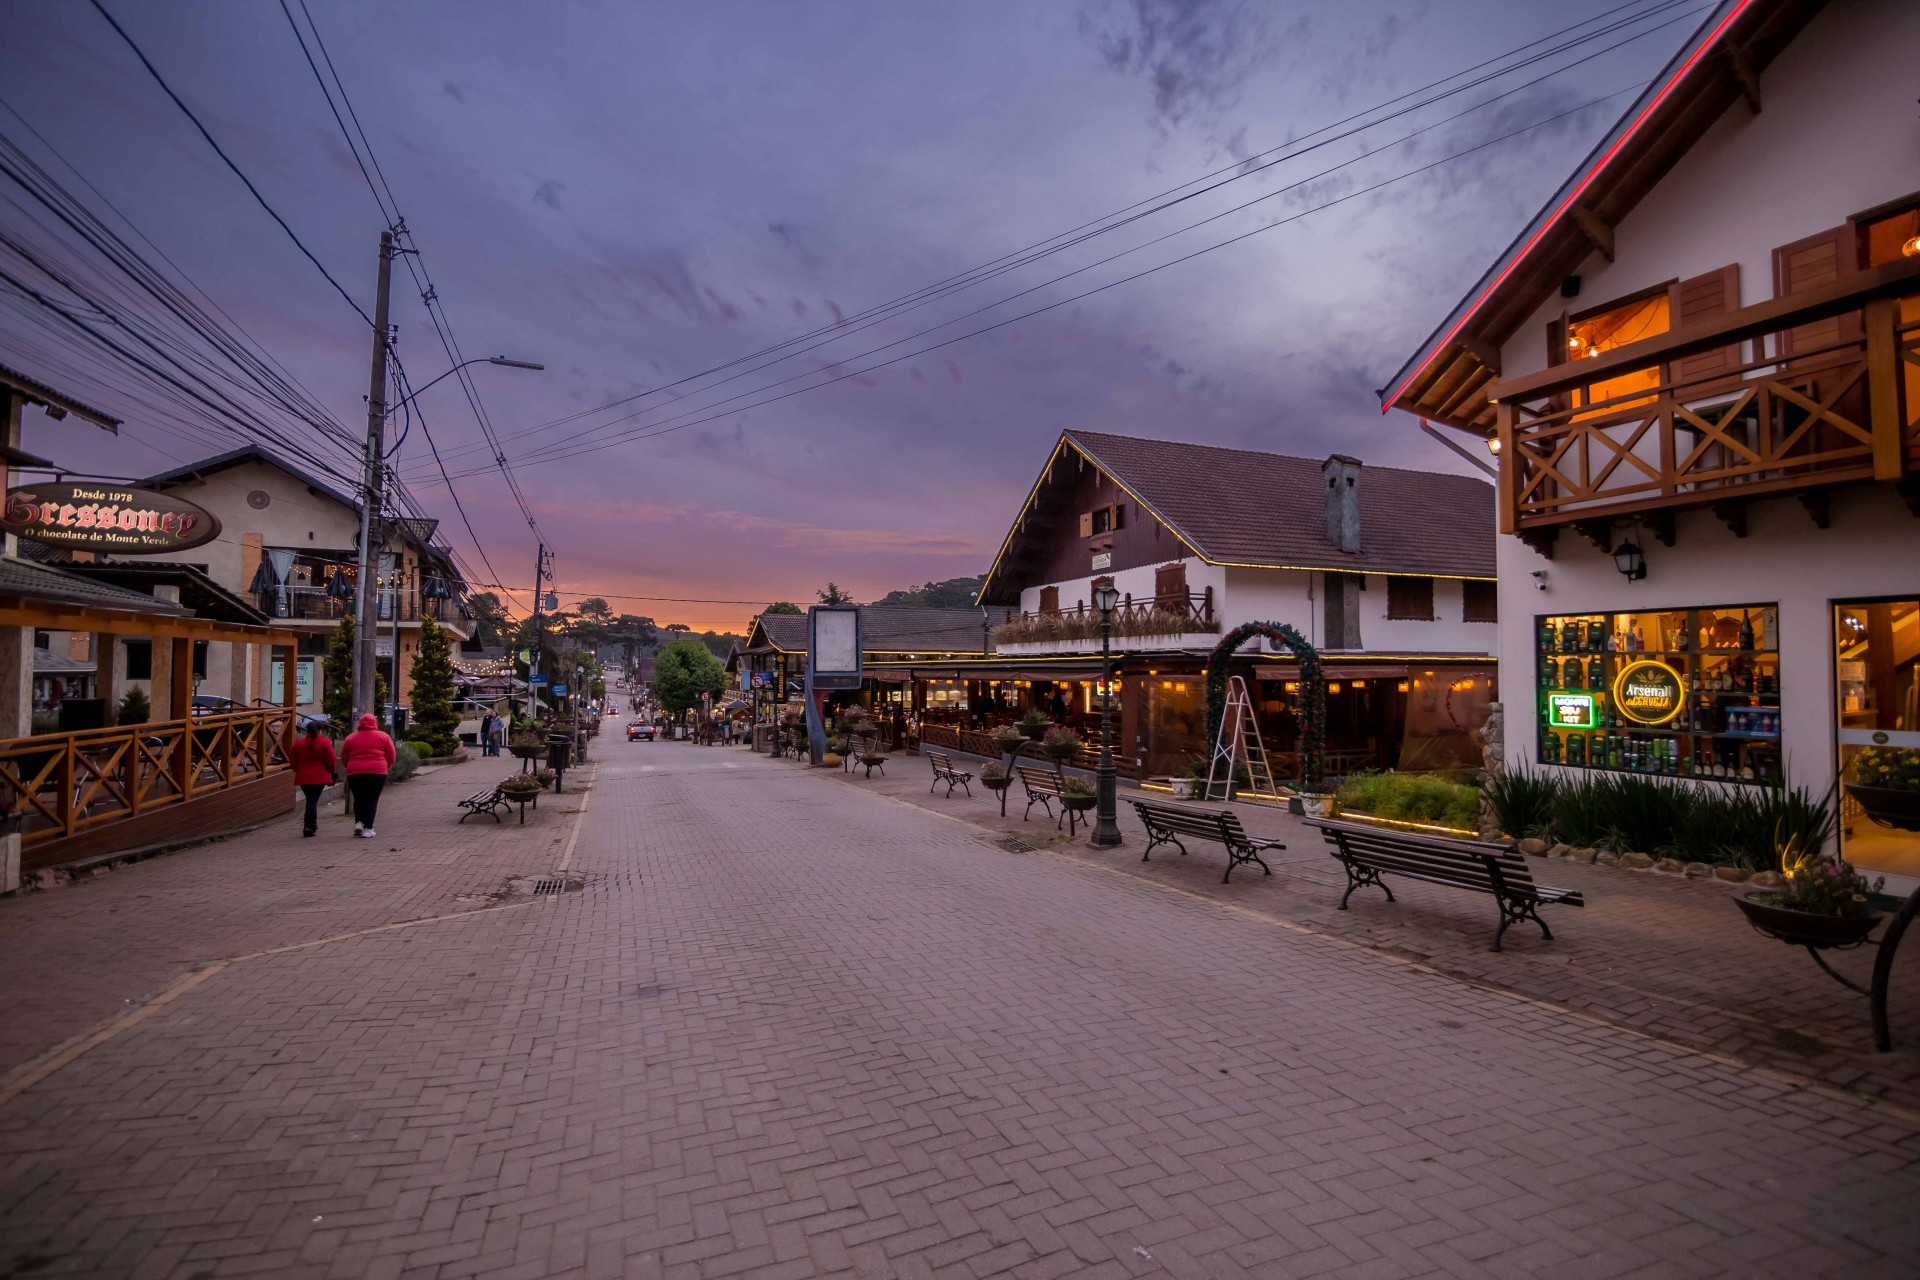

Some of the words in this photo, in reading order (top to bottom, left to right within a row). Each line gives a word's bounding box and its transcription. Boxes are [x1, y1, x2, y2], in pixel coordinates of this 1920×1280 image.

[73, 488, 105, 500] Desde
[109, 492, 133, 502] 1978
[5, 491, 199, 538] Gressoney
[25, 528, 35, 536] O
[37, 529, 88, 540] chocolate
[90, 532, 103, 541] de
[105, 533, 140, 544] Monte
[141, 535, 171, 545] Verde
[1626, 684, 1672, 697] Arsenal
